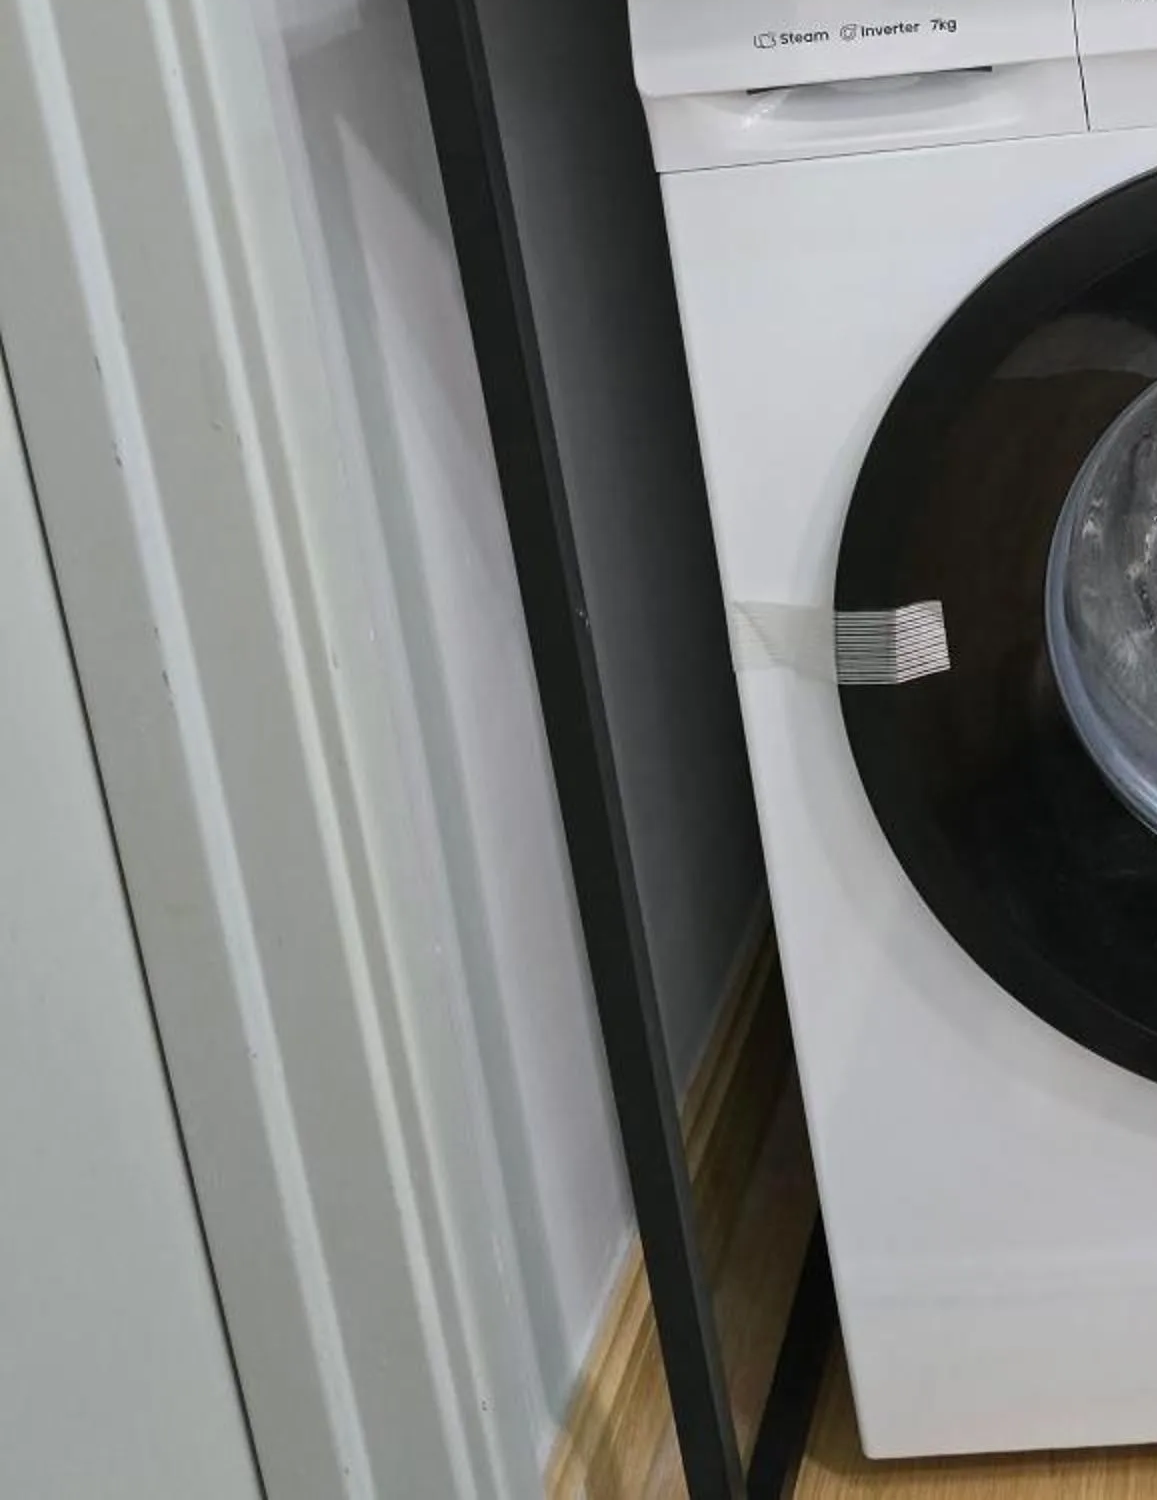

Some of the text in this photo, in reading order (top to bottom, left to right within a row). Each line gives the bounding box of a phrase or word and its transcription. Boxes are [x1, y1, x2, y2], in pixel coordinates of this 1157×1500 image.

[780, 19, 957, 44] Steam Inverter 7kg
